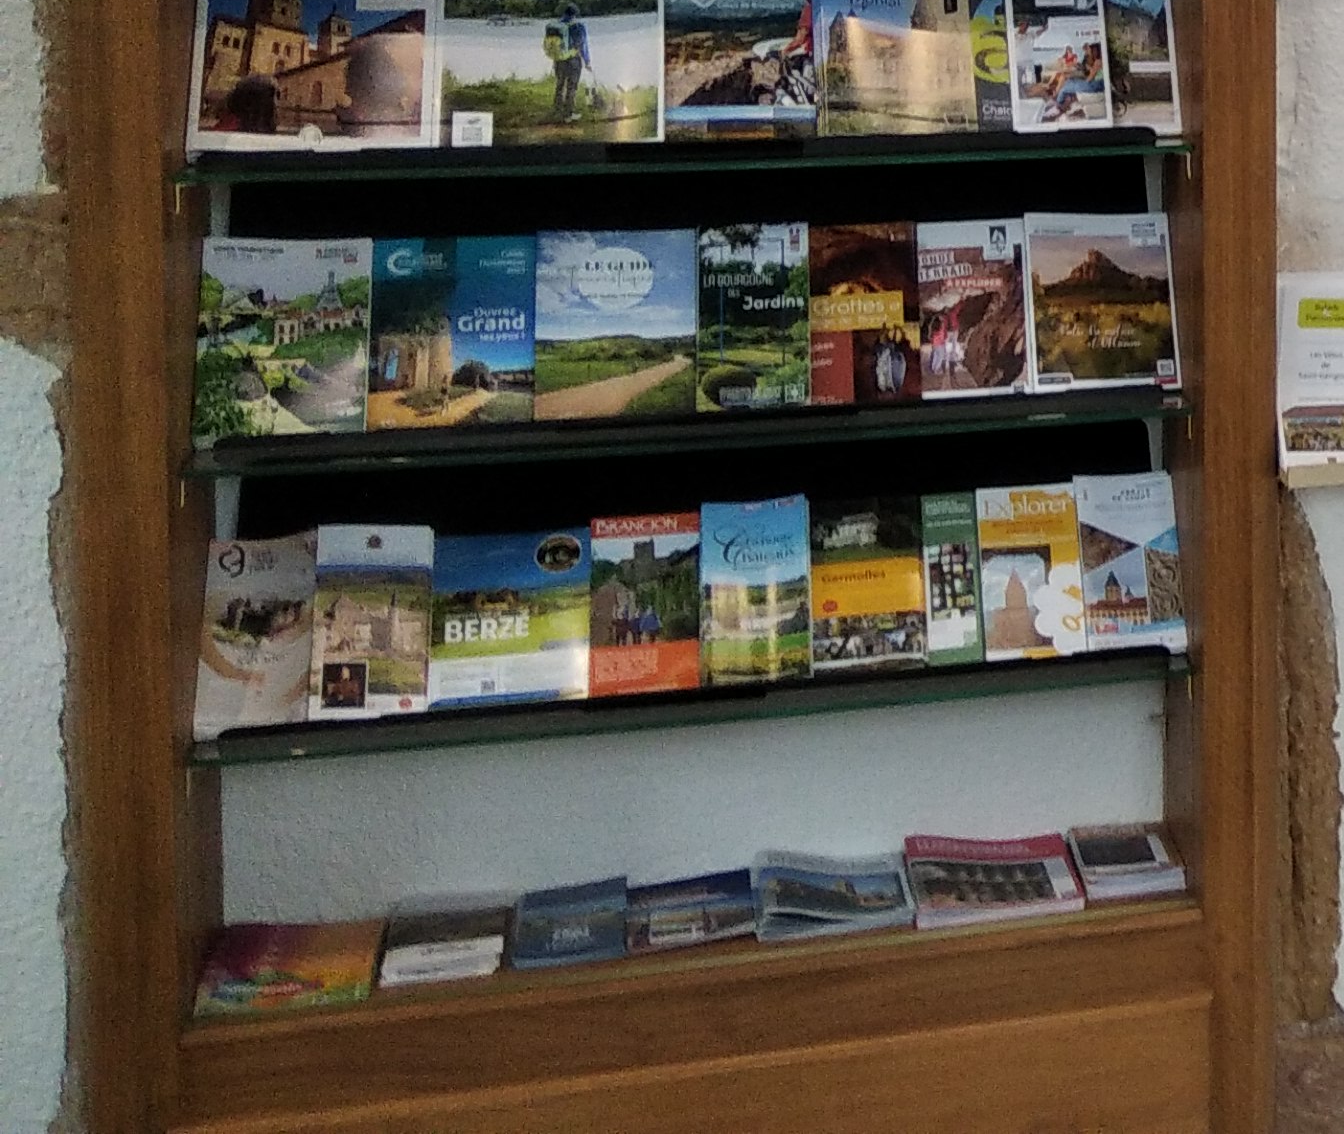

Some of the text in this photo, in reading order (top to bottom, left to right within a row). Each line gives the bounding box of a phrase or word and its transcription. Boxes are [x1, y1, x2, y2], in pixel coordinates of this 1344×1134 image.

[742, 294, 805, 312] Jardins
[813, 297, 885, 315] Grottes
[457, 311, 526, 333] Grand
